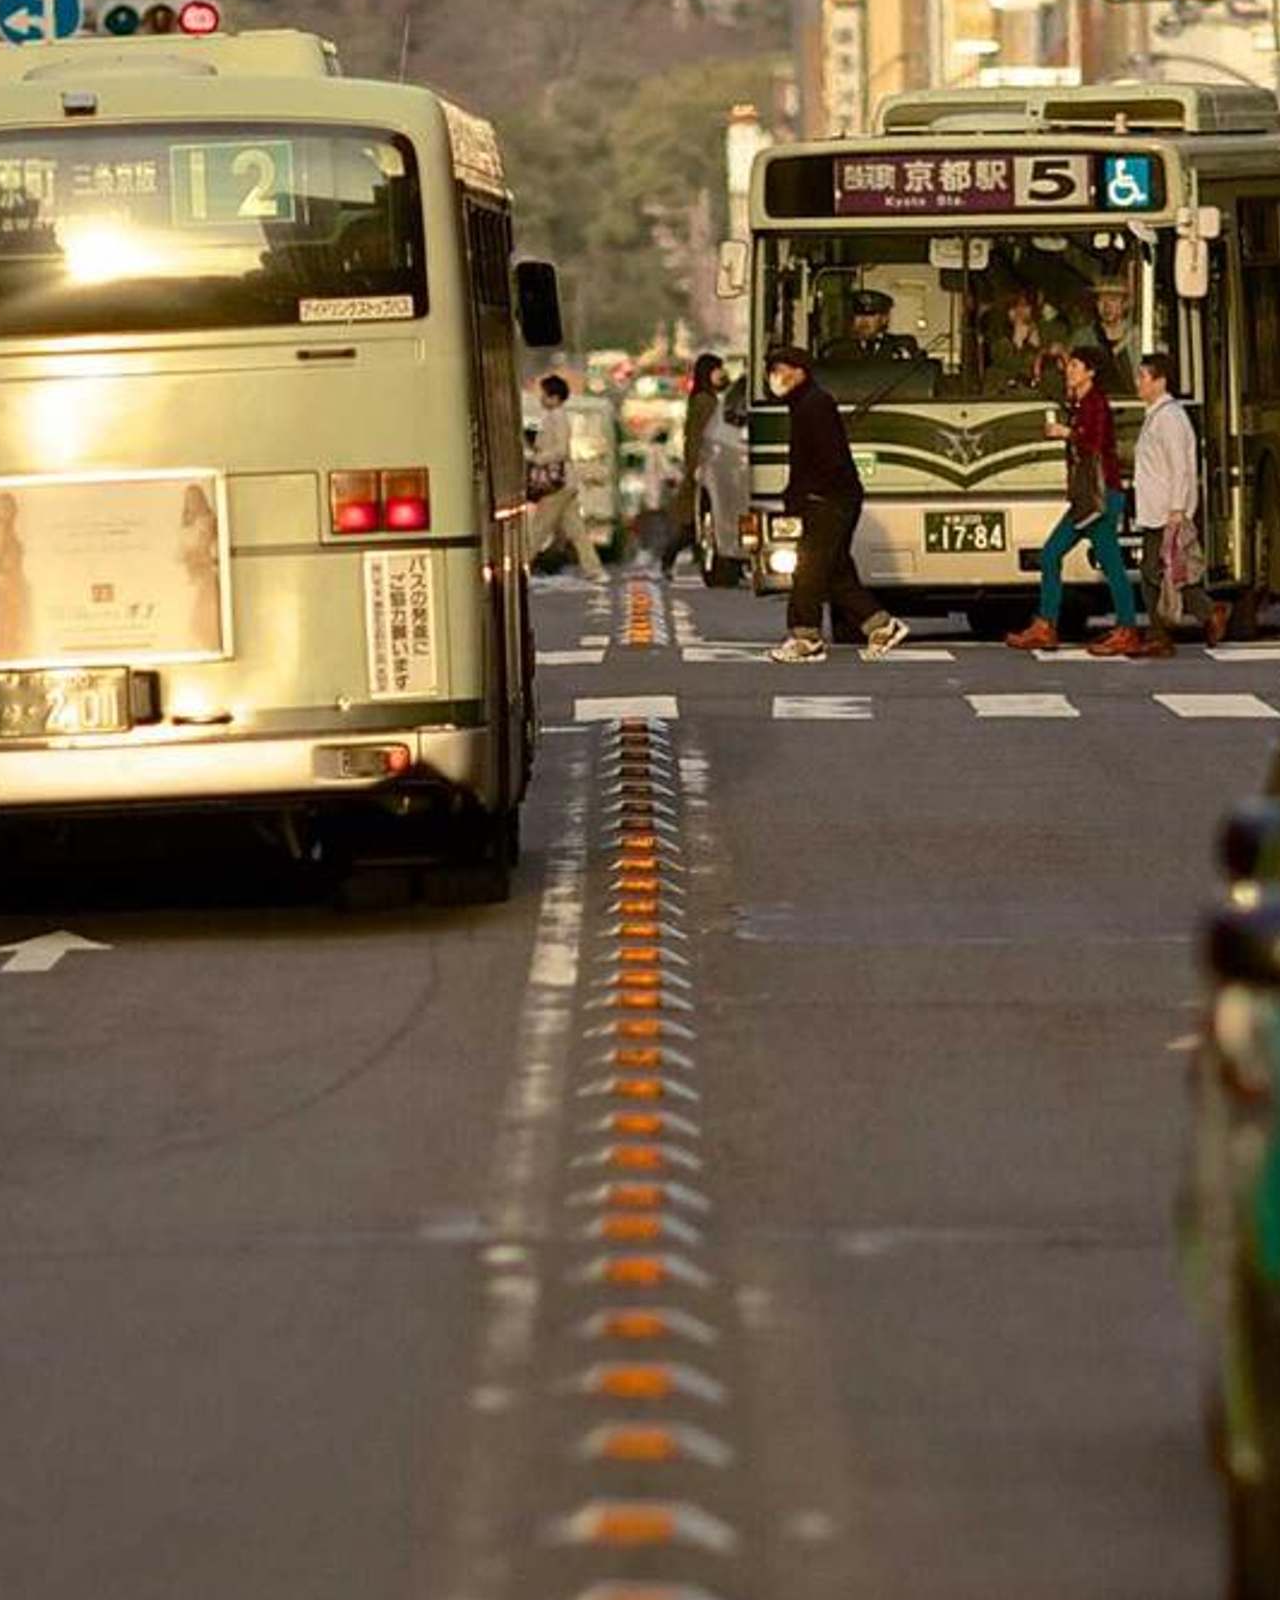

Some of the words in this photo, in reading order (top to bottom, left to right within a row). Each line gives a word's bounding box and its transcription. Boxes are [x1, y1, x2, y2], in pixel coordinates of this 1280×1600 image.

[903, 158, 1009, 192] 京都駅
[1027, 160, 1077, 200] 5
